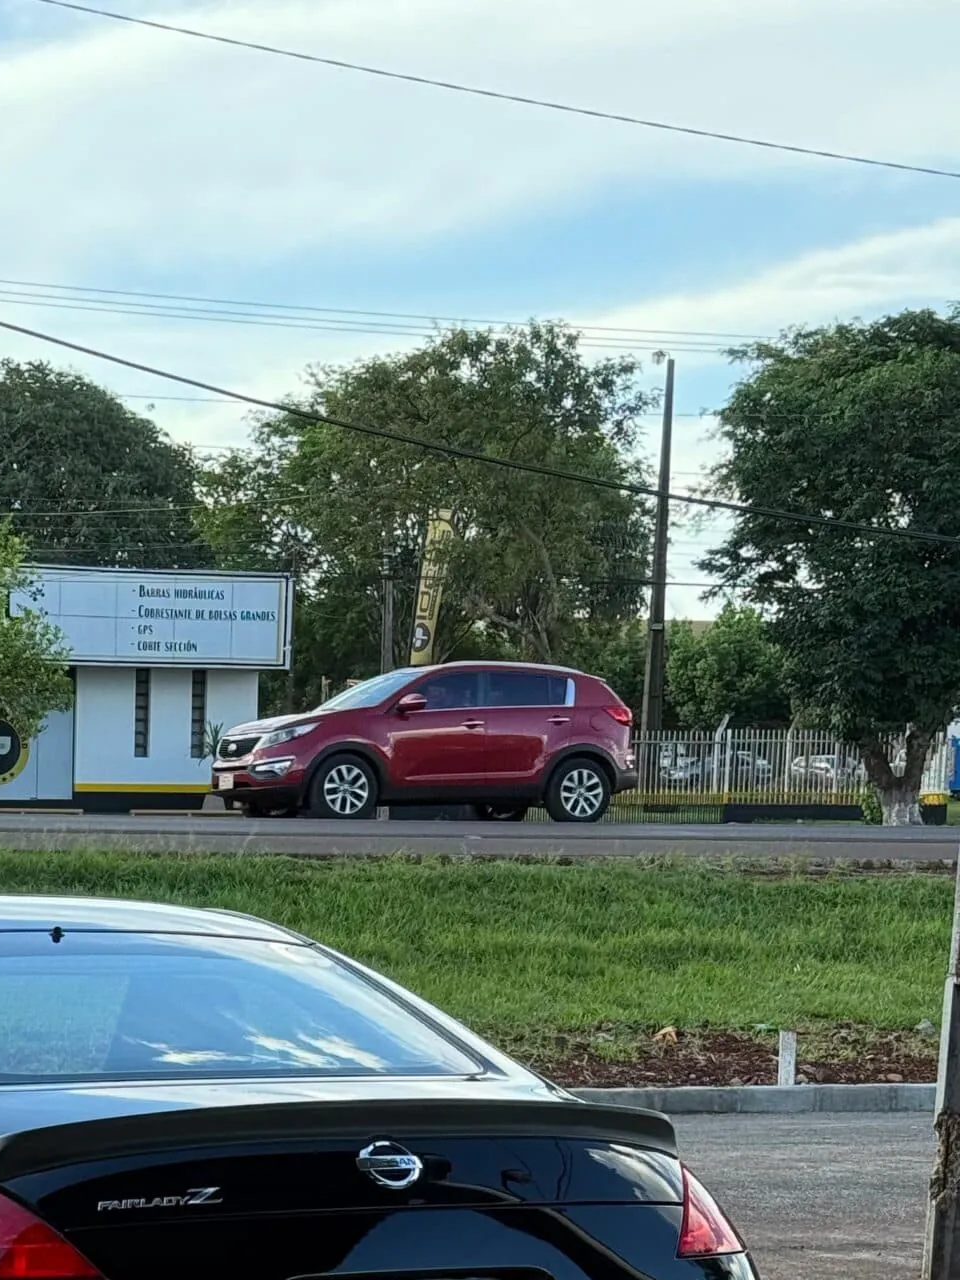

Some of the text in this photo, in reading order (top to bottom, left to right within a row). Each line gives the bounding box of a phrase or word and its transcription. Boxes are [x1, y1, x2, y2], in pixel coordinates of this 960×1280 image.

[195, 609, 205, 620] DE
[240, 610, 276, 621] GRANDES
[137, 624, 153, 635] GPS
